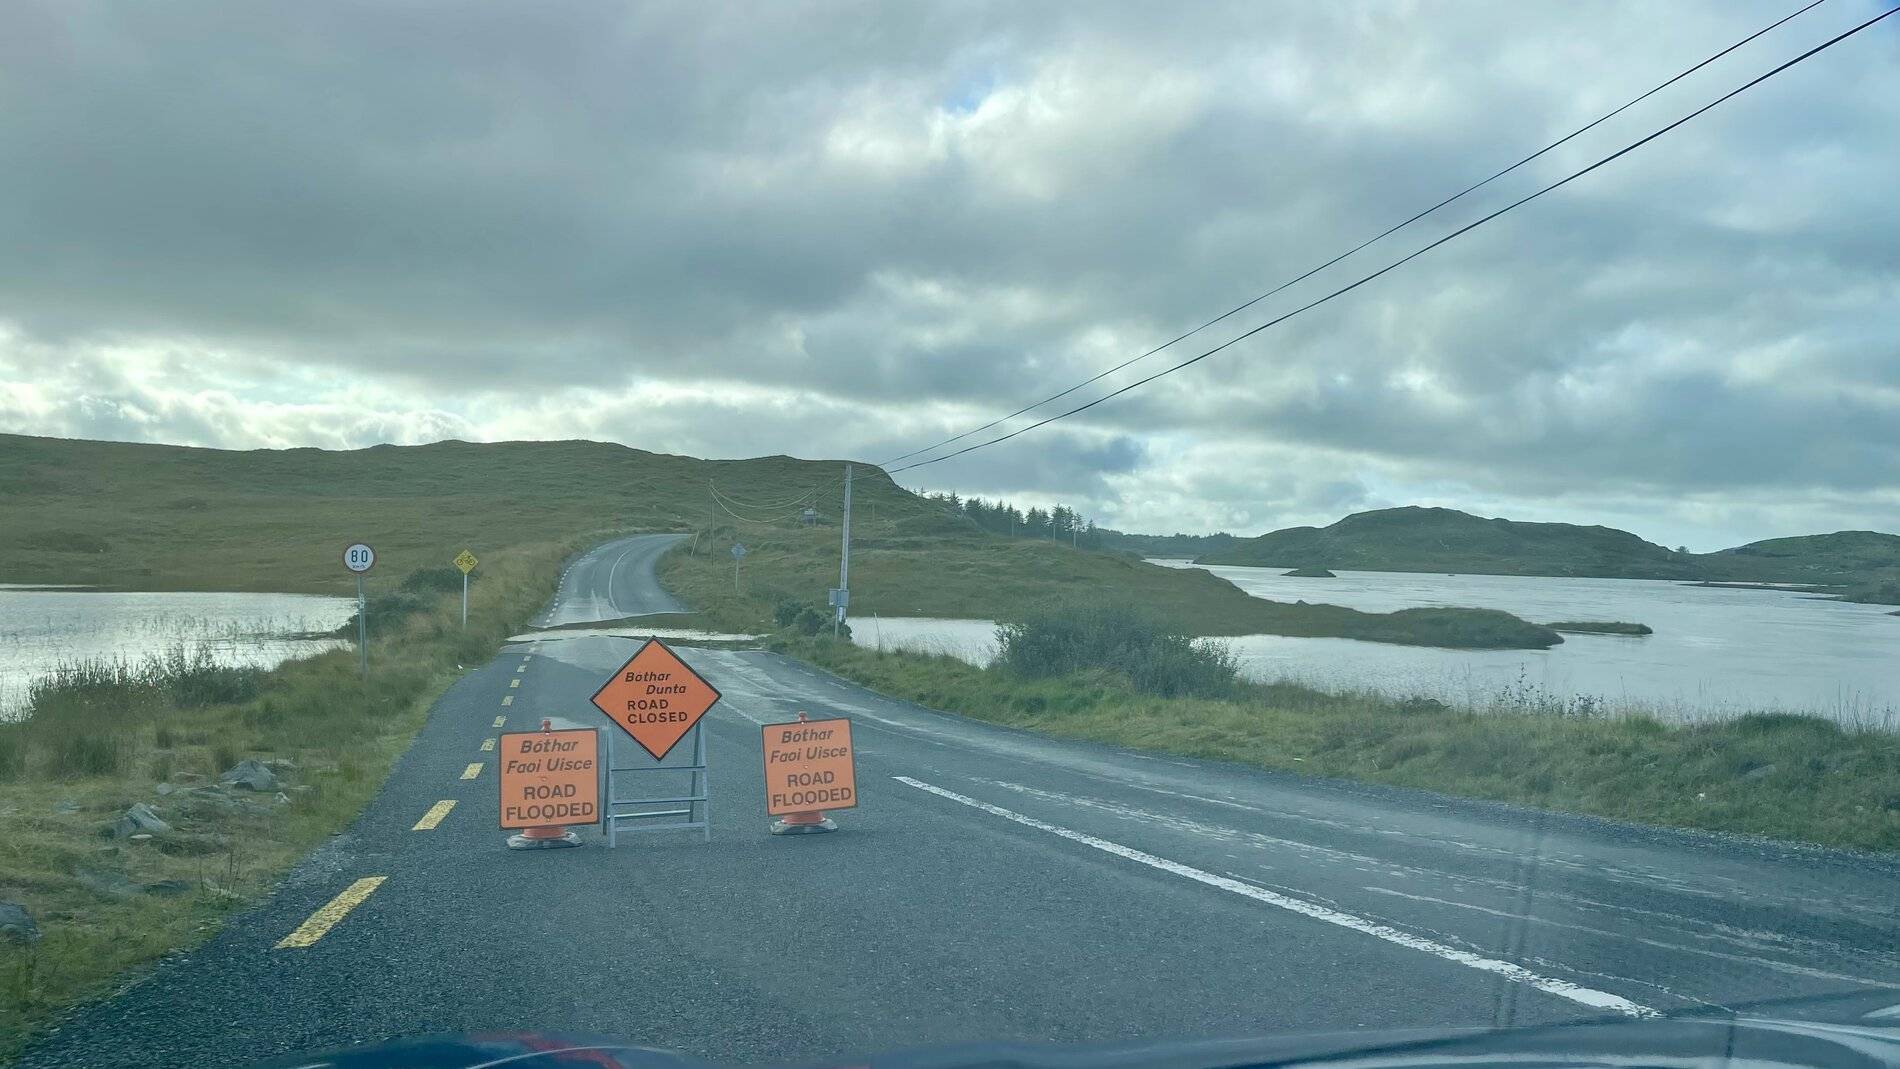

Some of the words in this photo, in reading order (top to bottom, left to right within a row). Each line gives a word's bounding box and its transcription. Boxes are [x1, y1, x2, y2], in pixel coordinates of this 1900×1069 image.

[351, 549, 368, 563] 80
[646, 683, 686, 695] Dunta
[627, 699, 669, 710] ROAD
[627, 712, 688, 724] CLOSED
[770, 749, 802, 763] Faoi
[806, 746, 848, 761] Uisce
[506, 759, 542, 774] Faoi
[546, 758, 592, 772] Uisce
[787, 771, 835, 787] ROAD
[523, 783, 577, 800] ROAD
[772, 788, 852, 807] FLOODED
[506, 802, 594, 821] FLOODED
